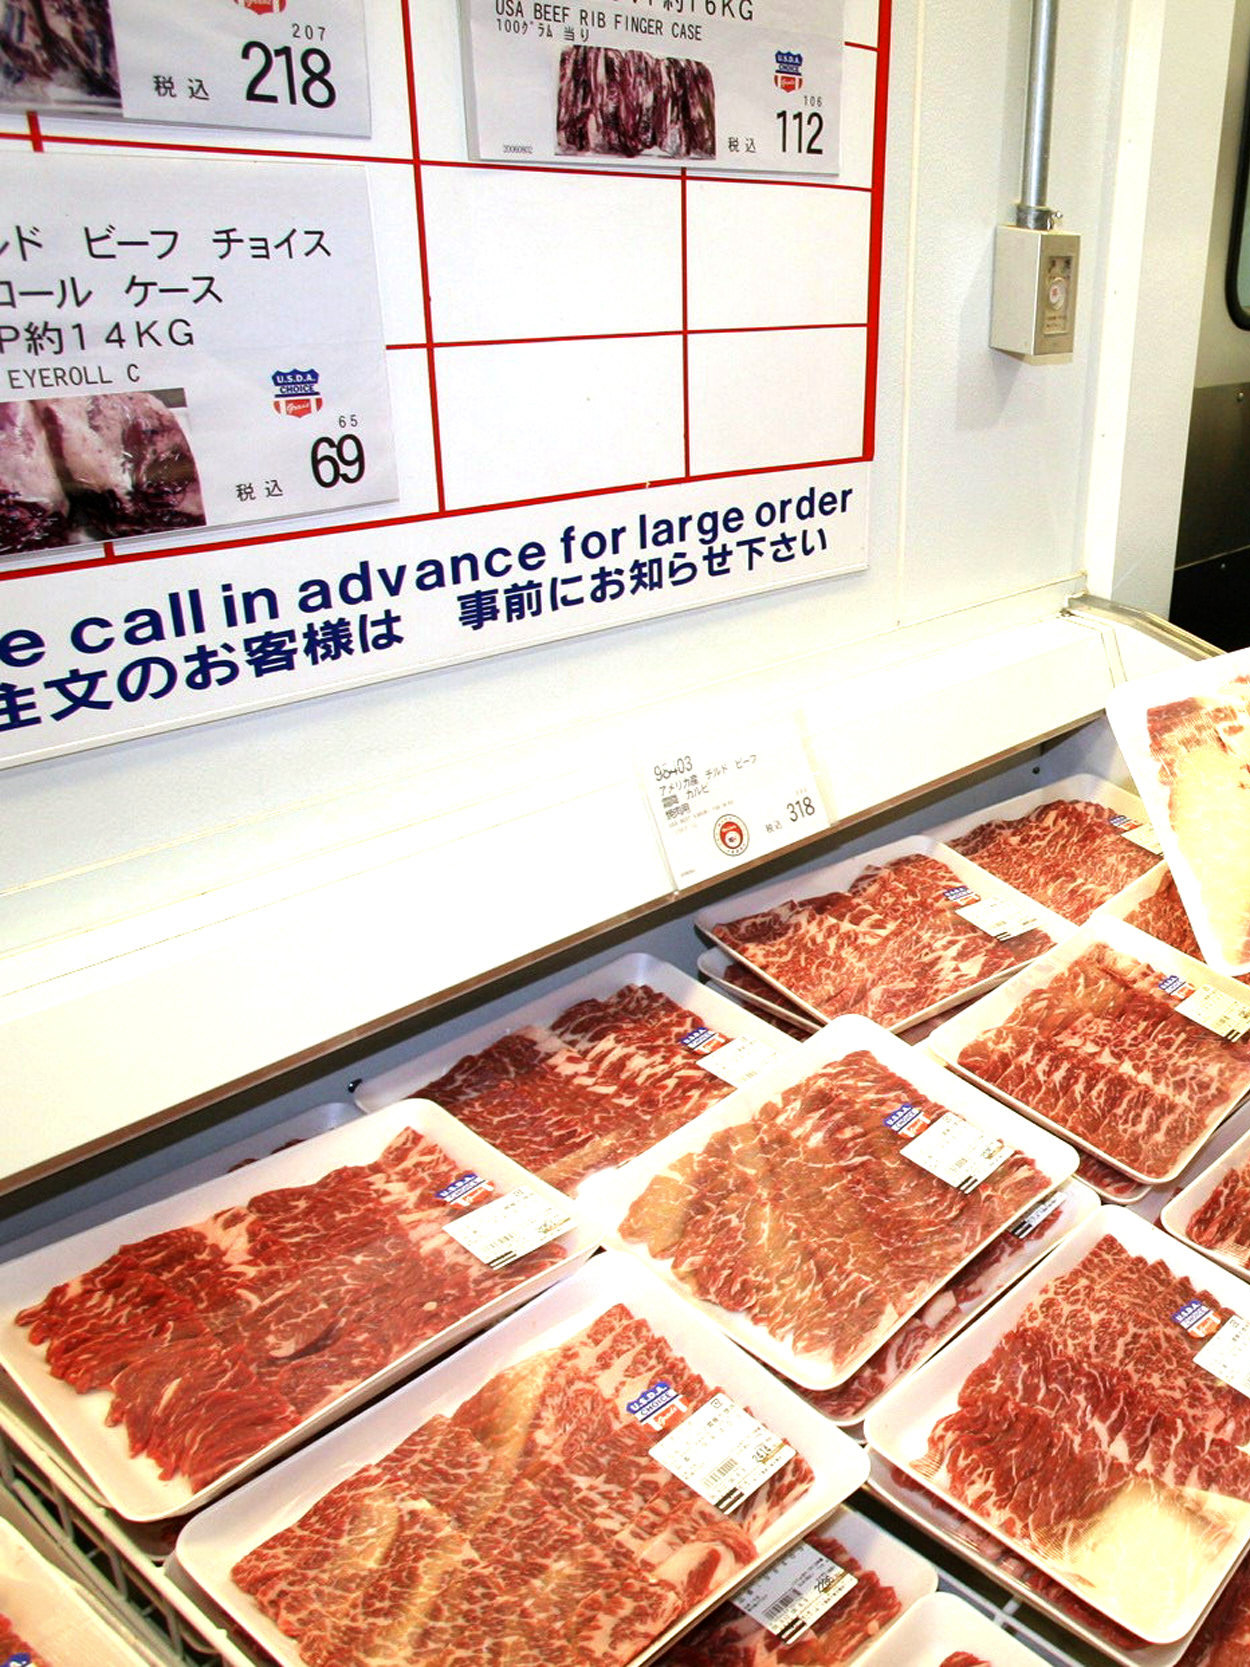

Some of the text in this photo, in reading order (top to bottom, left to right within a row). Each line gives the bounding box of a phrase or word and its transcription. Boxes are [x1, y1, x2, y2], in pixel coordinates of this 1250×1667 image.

[291, 23, 326, 40] 207
[495, 0, 702, 41] USA BEEF RIB FINGER CASE
[241, 40, 337, 109] 218
[776, 110, 824, 156] 112
[83, 224, 179, 260] ビーフ
[212, 227, 332, 261] チョイス
[125, 275, 223, 307] ケース
[8, 364, 141, 390] EYEROLL C
[280, 383, 315, 394] CHOICE
[338, 414, 358, 428] 65
[311, 434, 366, 488] 69
[70, 589, 206, 655] call
[221, 583, 280, 628] in
[298, 539, 547, 614] advance
[560, 525, 627, 564] for
[639, 507, 744, 551] large
[755, 486, 853, 527] order
[457, 527, 829, 632] 事前にお知らせ下さい
[786, 796, 815, 823] 318
